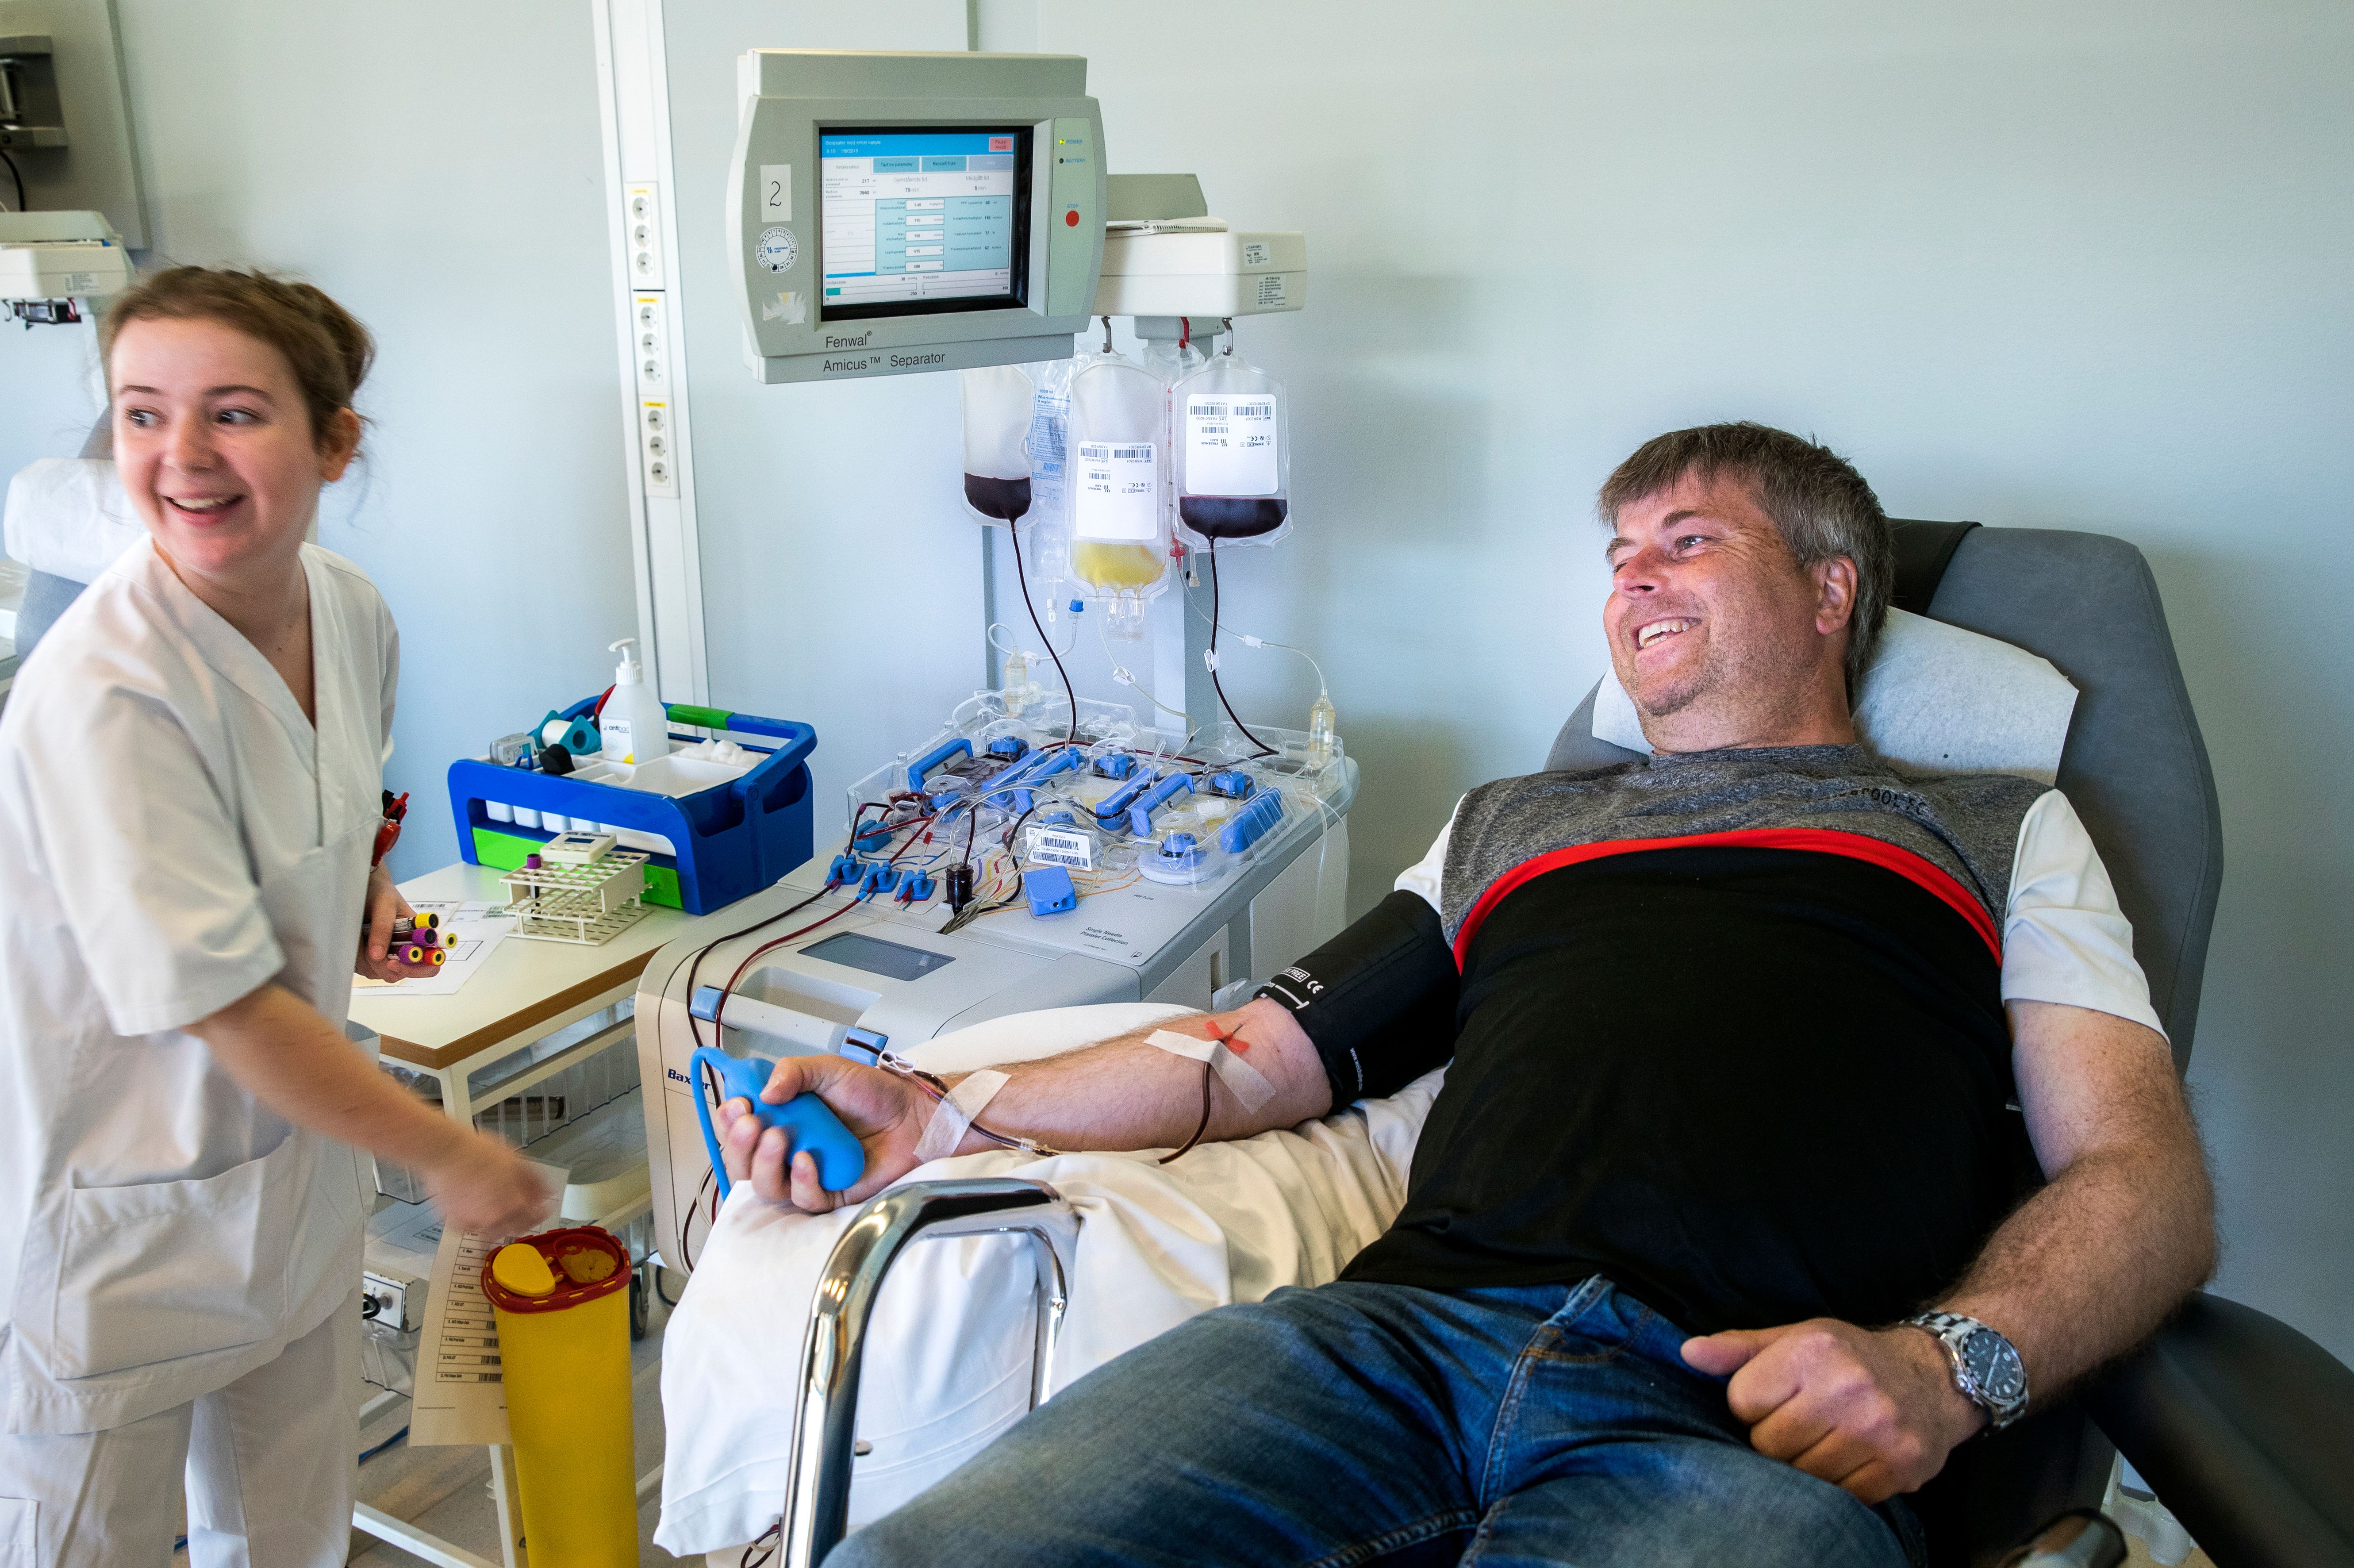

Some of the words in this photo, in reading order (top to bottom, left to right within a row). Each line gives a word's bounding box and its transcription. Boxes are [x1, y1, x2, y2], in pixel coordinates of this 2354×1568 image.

[770, 181, 781, 206] 2
[891, 353, 945, 368] Separator
[1080, 931, 1101, 939] Platelet
[1101, 936, 1129, 945] Collection
[1289, 969, 1306, 980] FREE
[668, 1068, 711, 1090] Baxr
